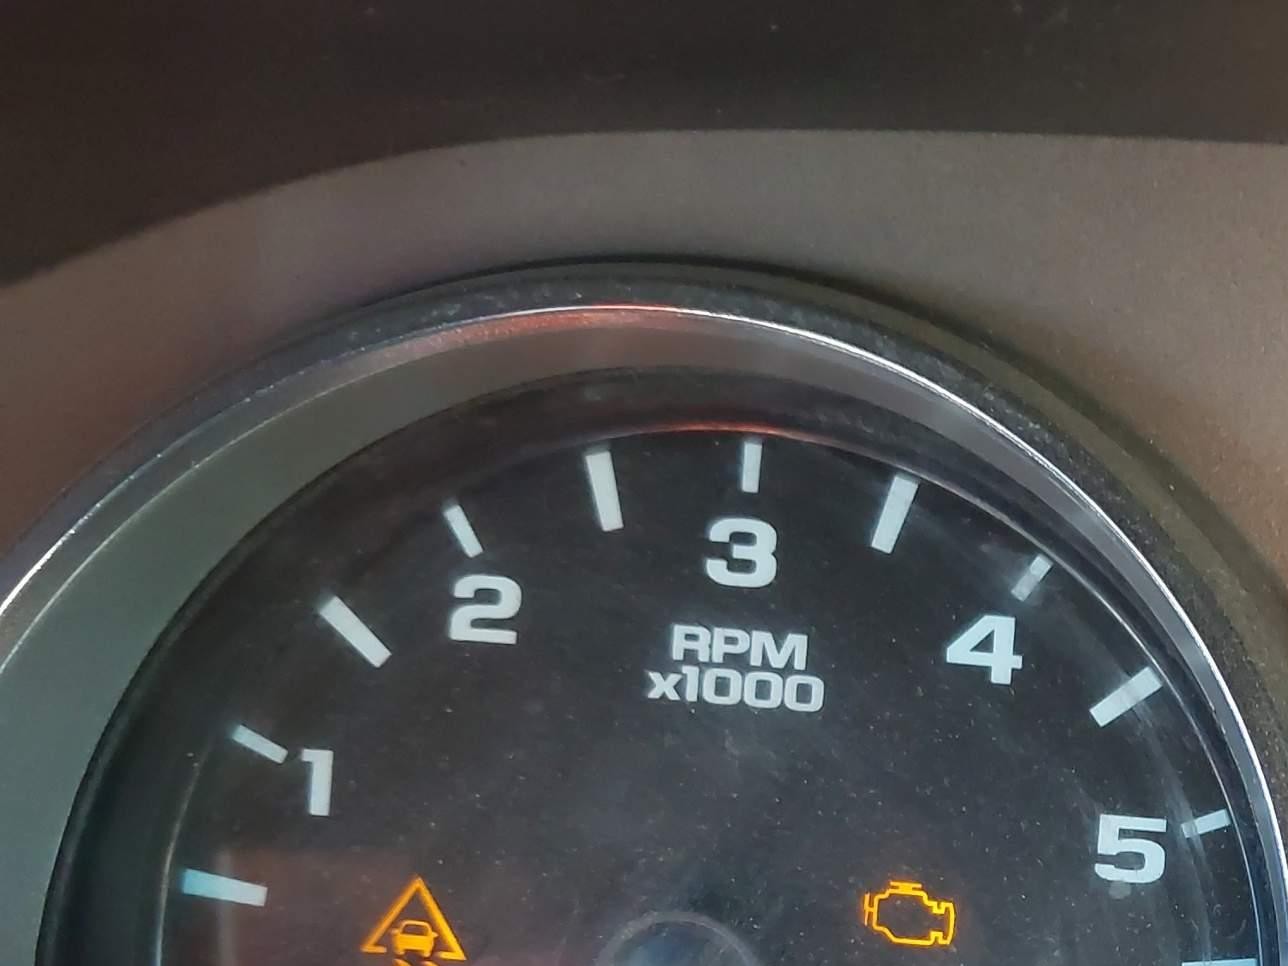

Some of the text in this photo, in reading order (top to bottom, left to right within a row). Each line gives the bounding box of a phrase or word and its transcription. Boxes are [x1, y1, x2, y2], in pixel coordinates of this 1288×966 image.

[706, 518, 778, 589] 3
[448, 575, 523, 645] 2
[671, 624, 808, 672] RPM
[946, 614, 1023, 685] 4
[646, 669, 824, 713] x1000
[301, 750, 333, 817] 1
[1094, 814, 1167, 884] 5
